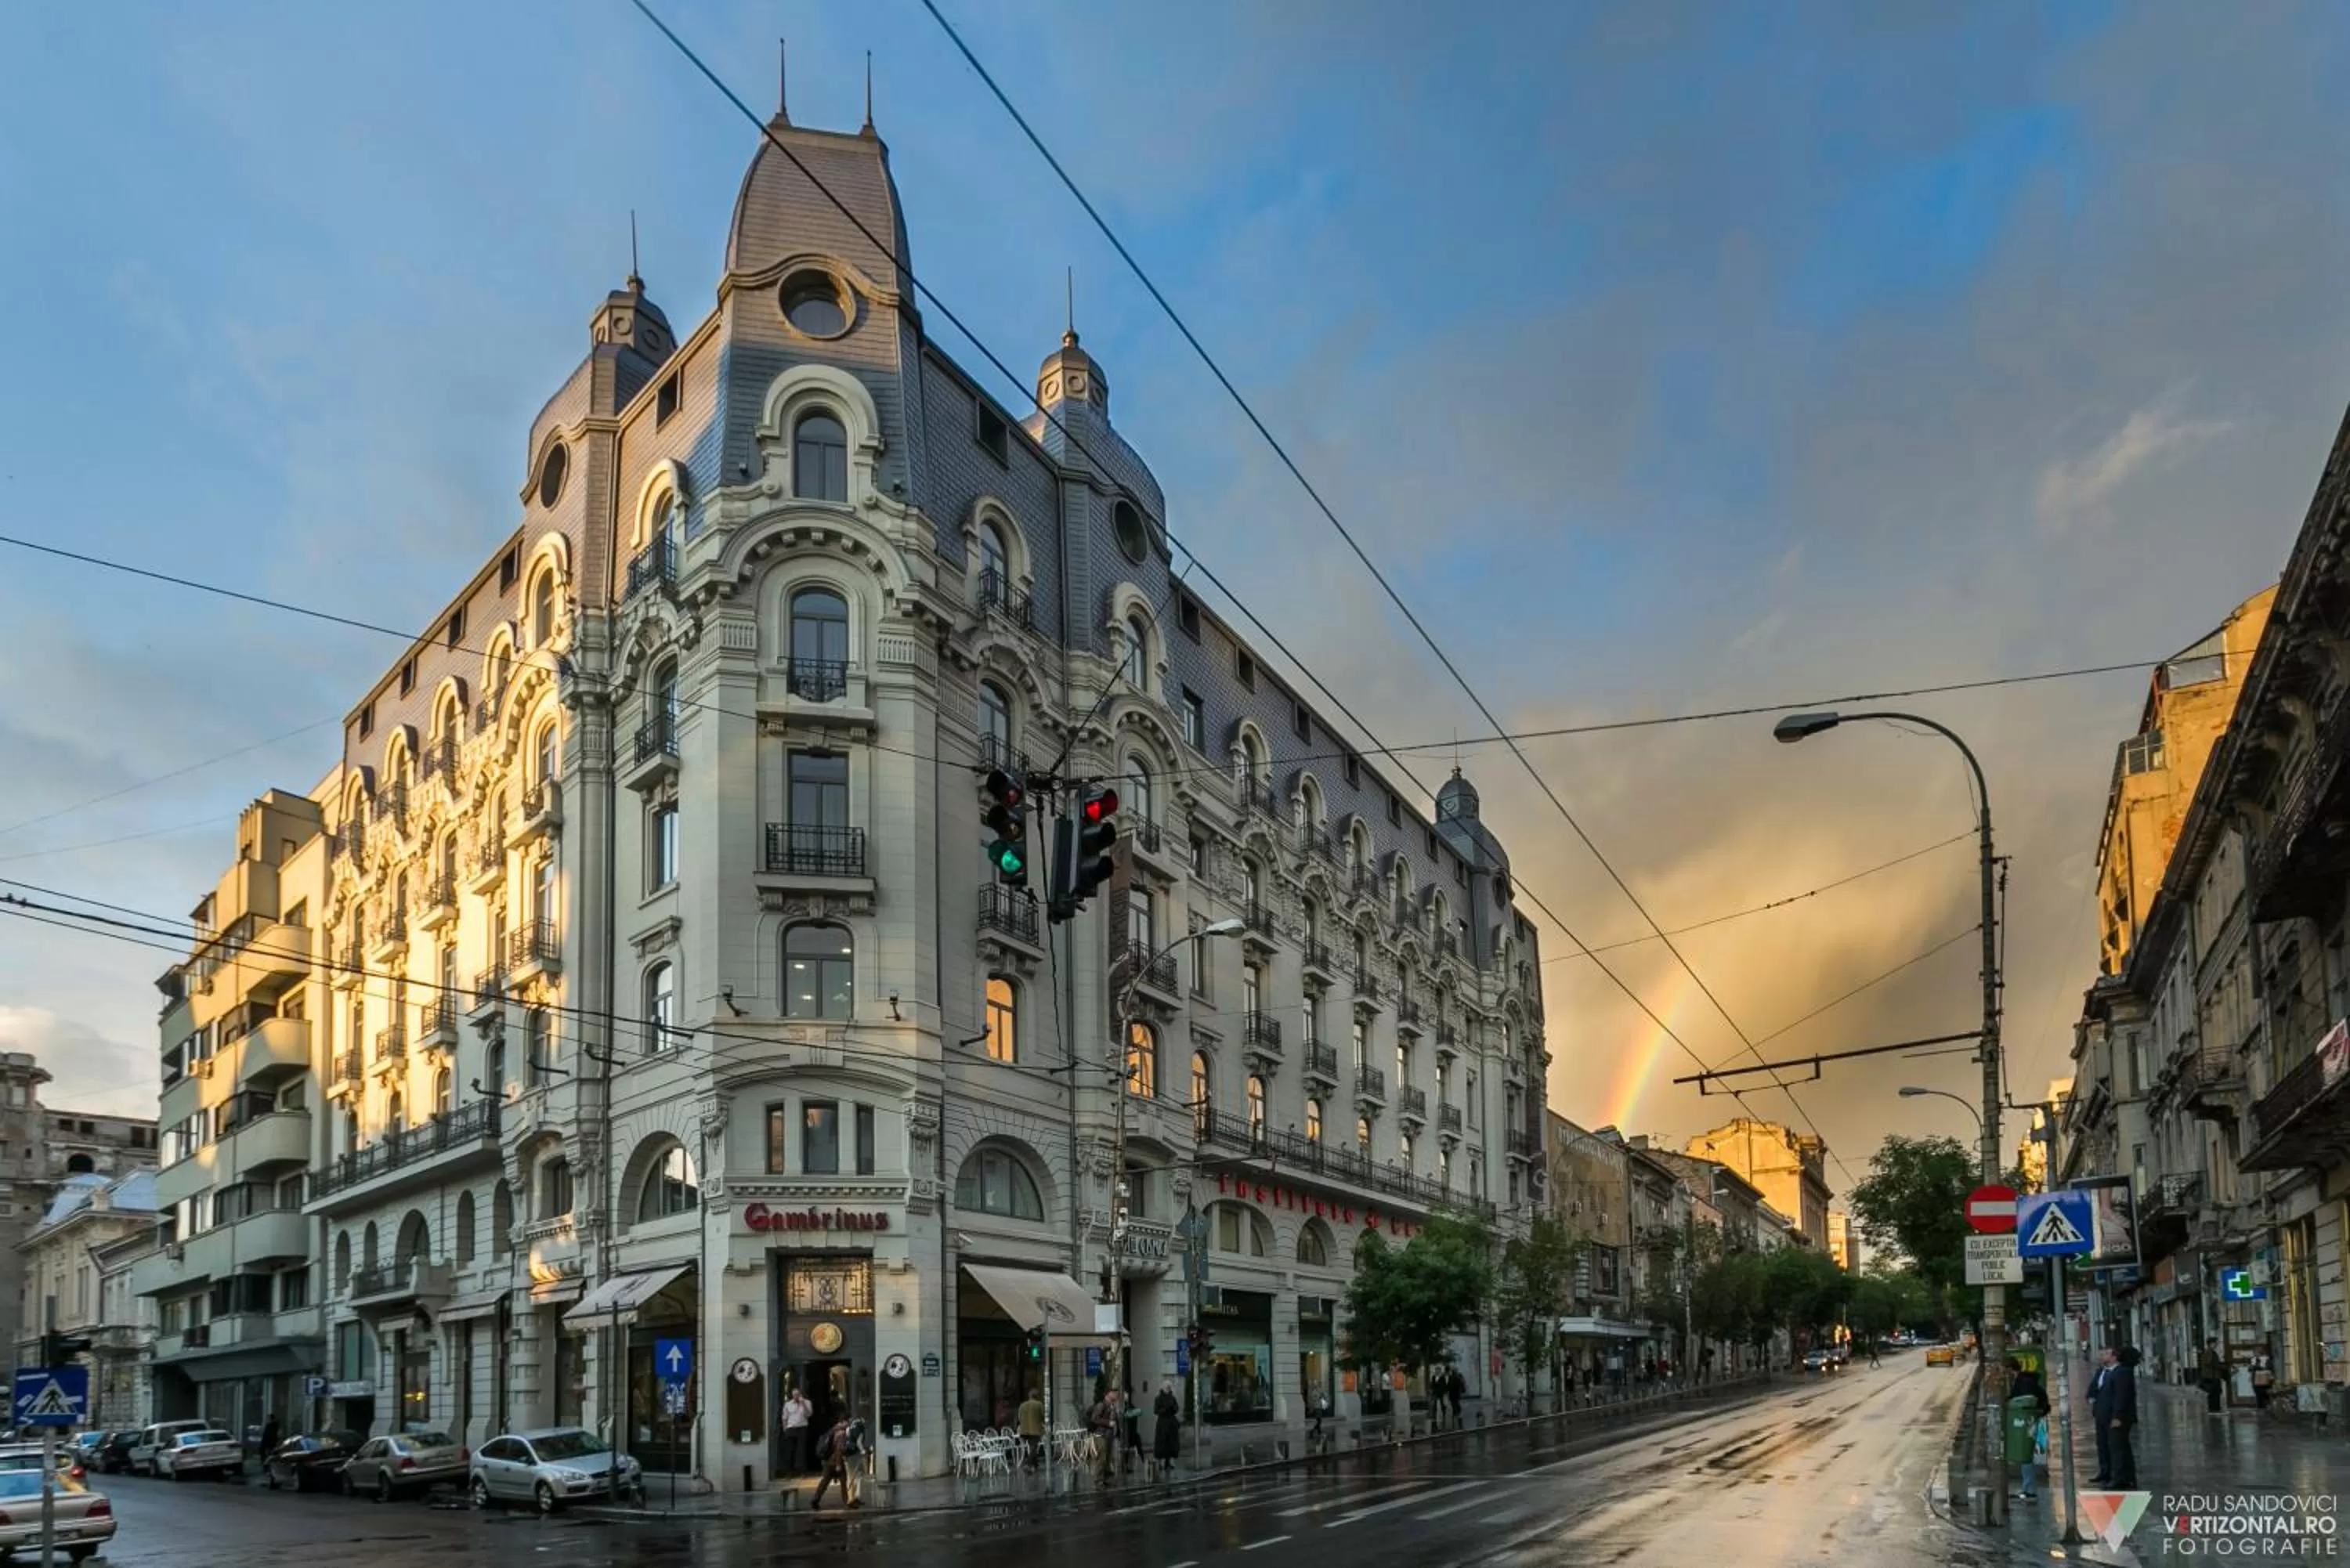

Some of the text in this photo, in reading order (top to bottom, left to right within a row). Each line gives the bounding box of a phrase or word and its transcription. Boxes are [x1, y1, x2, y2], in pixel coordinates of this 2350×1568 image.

[744, 1202, 888, 1230] Gambrinus
[1981, 1260, 2006, 1270] PUBLIC
[1983, 1271, 2006, 1281] LOCAL
[309, 1378, 325, 1395] P
